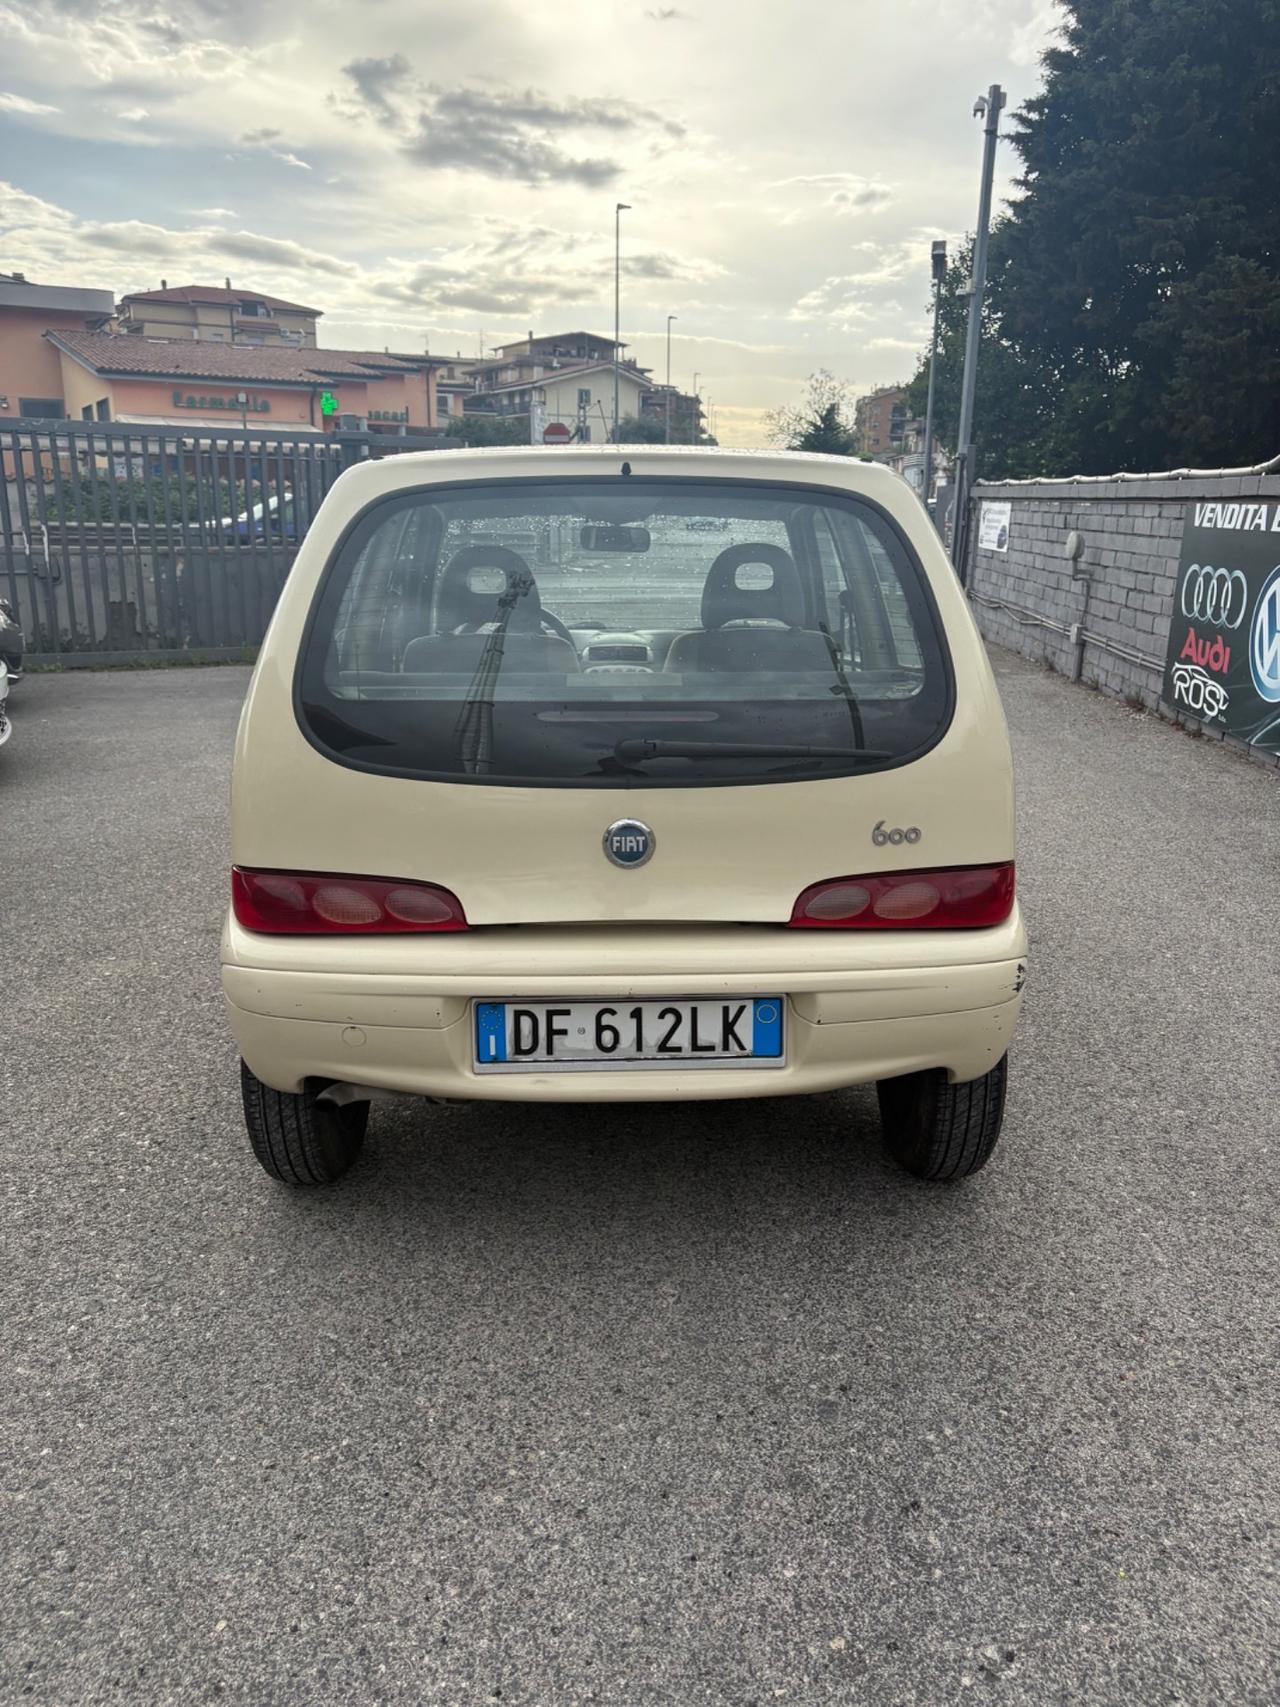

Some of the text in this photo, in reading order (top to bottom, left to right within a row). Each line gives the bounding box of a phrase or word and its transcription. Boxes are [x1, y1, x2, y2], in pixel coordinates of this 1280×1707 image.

[1193, 502, 1268, 532] VENDITA
[1181, 627, 1230, 674] Audi
[612, 836, 646, 852] FIAT
[871, 820, 922, 847] 600
[513, 1008, 572, 1056] DF
